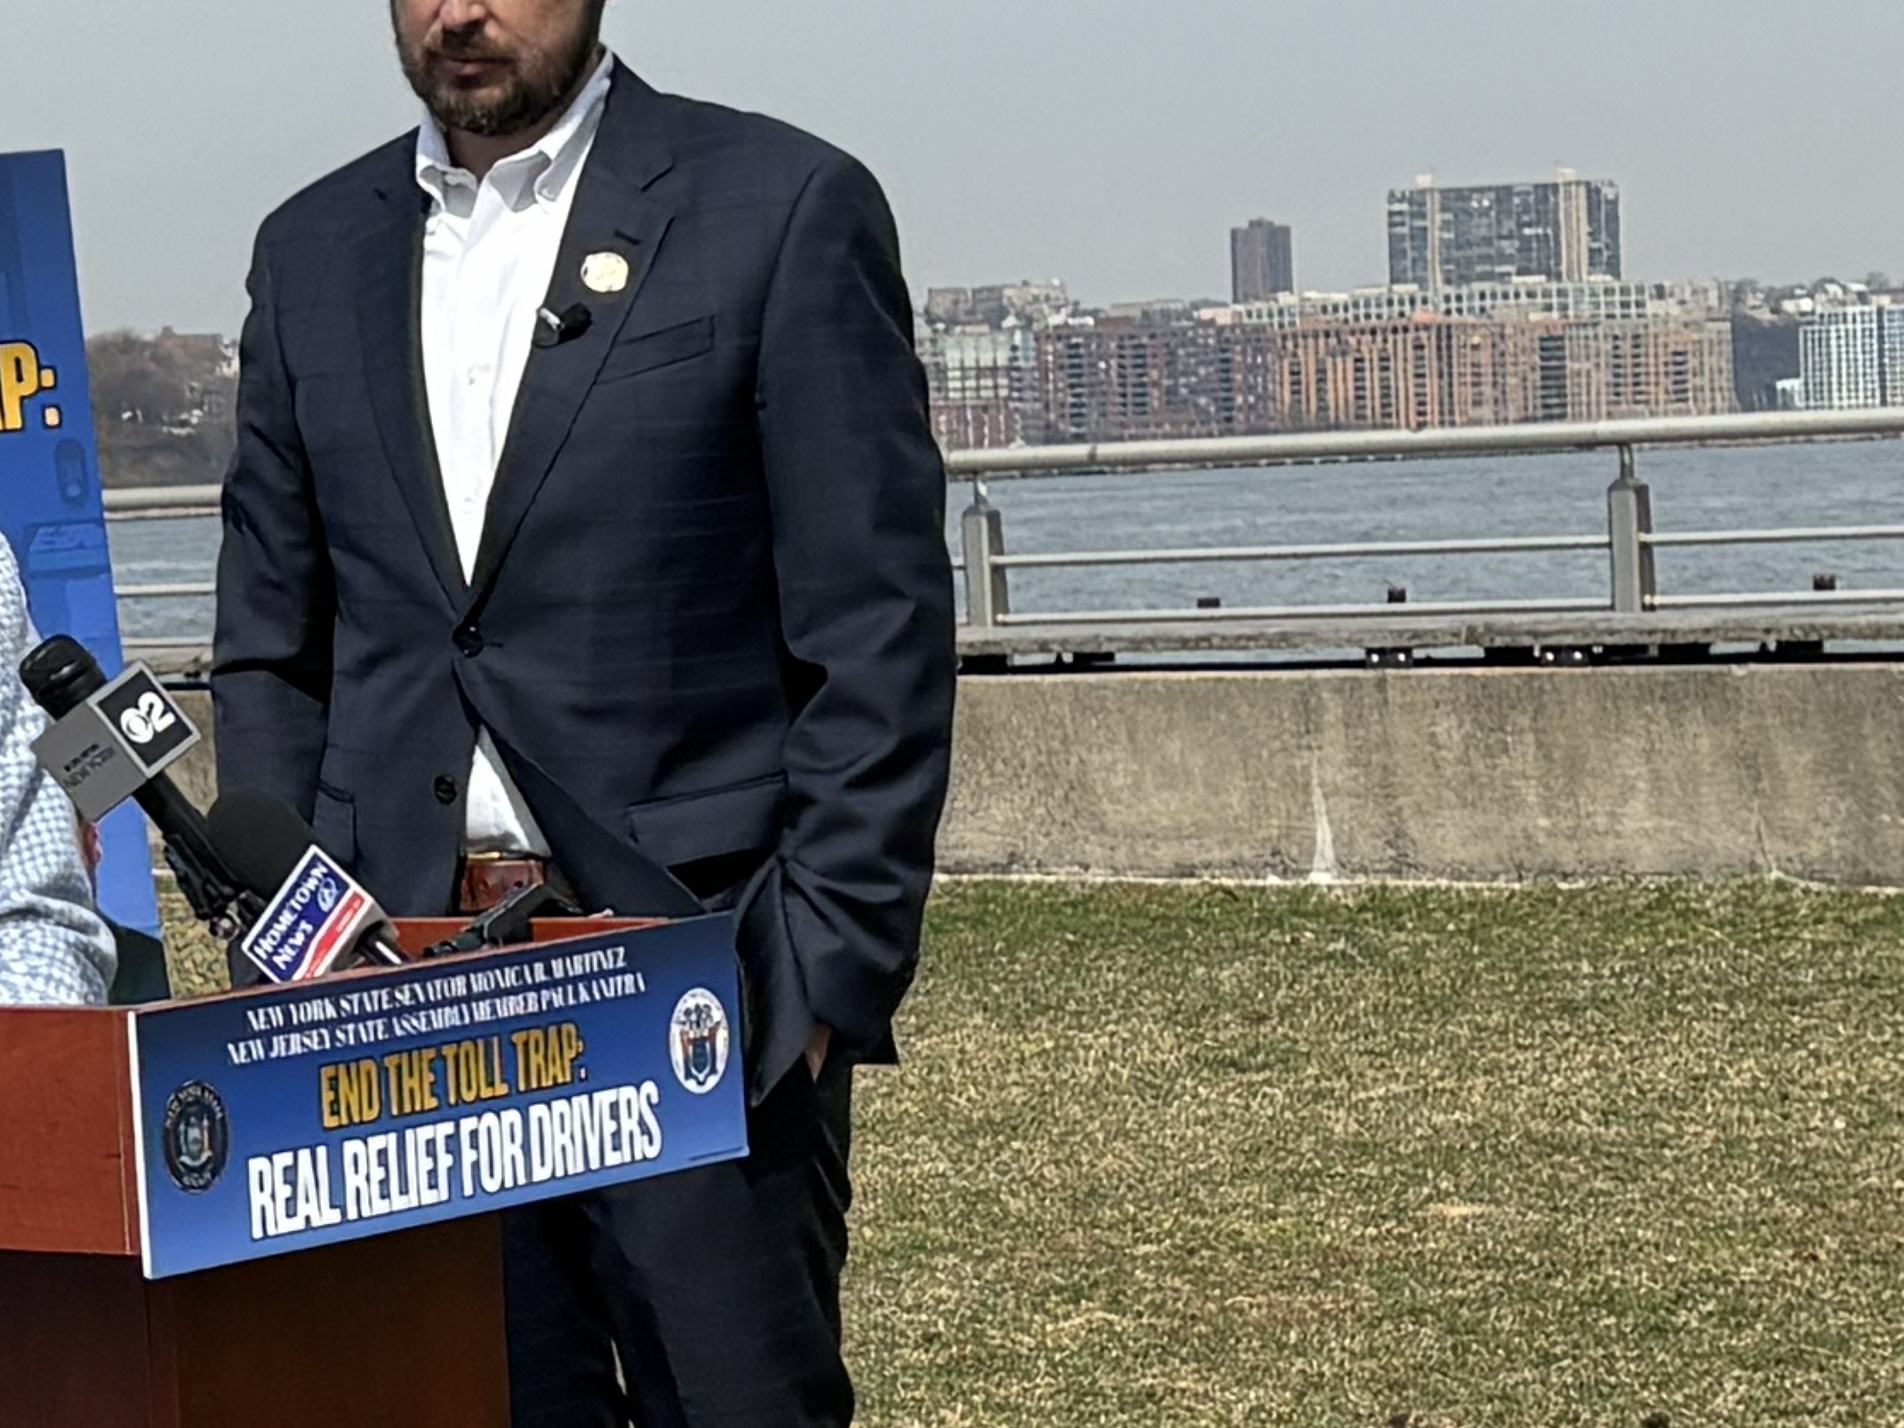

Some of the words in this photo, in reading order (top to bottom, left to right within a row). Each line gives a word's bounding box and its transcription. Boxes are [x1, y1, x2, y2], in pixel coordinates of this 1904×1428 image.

[253, 862, 328, 960] HOMETOWN
[321, 1060, 380, 1128] END
[384, 1049, 438, 1116] THE
[442, 1037, 509, 1105] TOLL
[512, 1024, 585, 1091] TRAP:
[248, 1145, 342, 1239] REAL
[343, 1121, 455, 1220] RELIEF
[460, 1109, 527, 1196] FOR
[529, 1081, 661, 1182] DRIVERS
